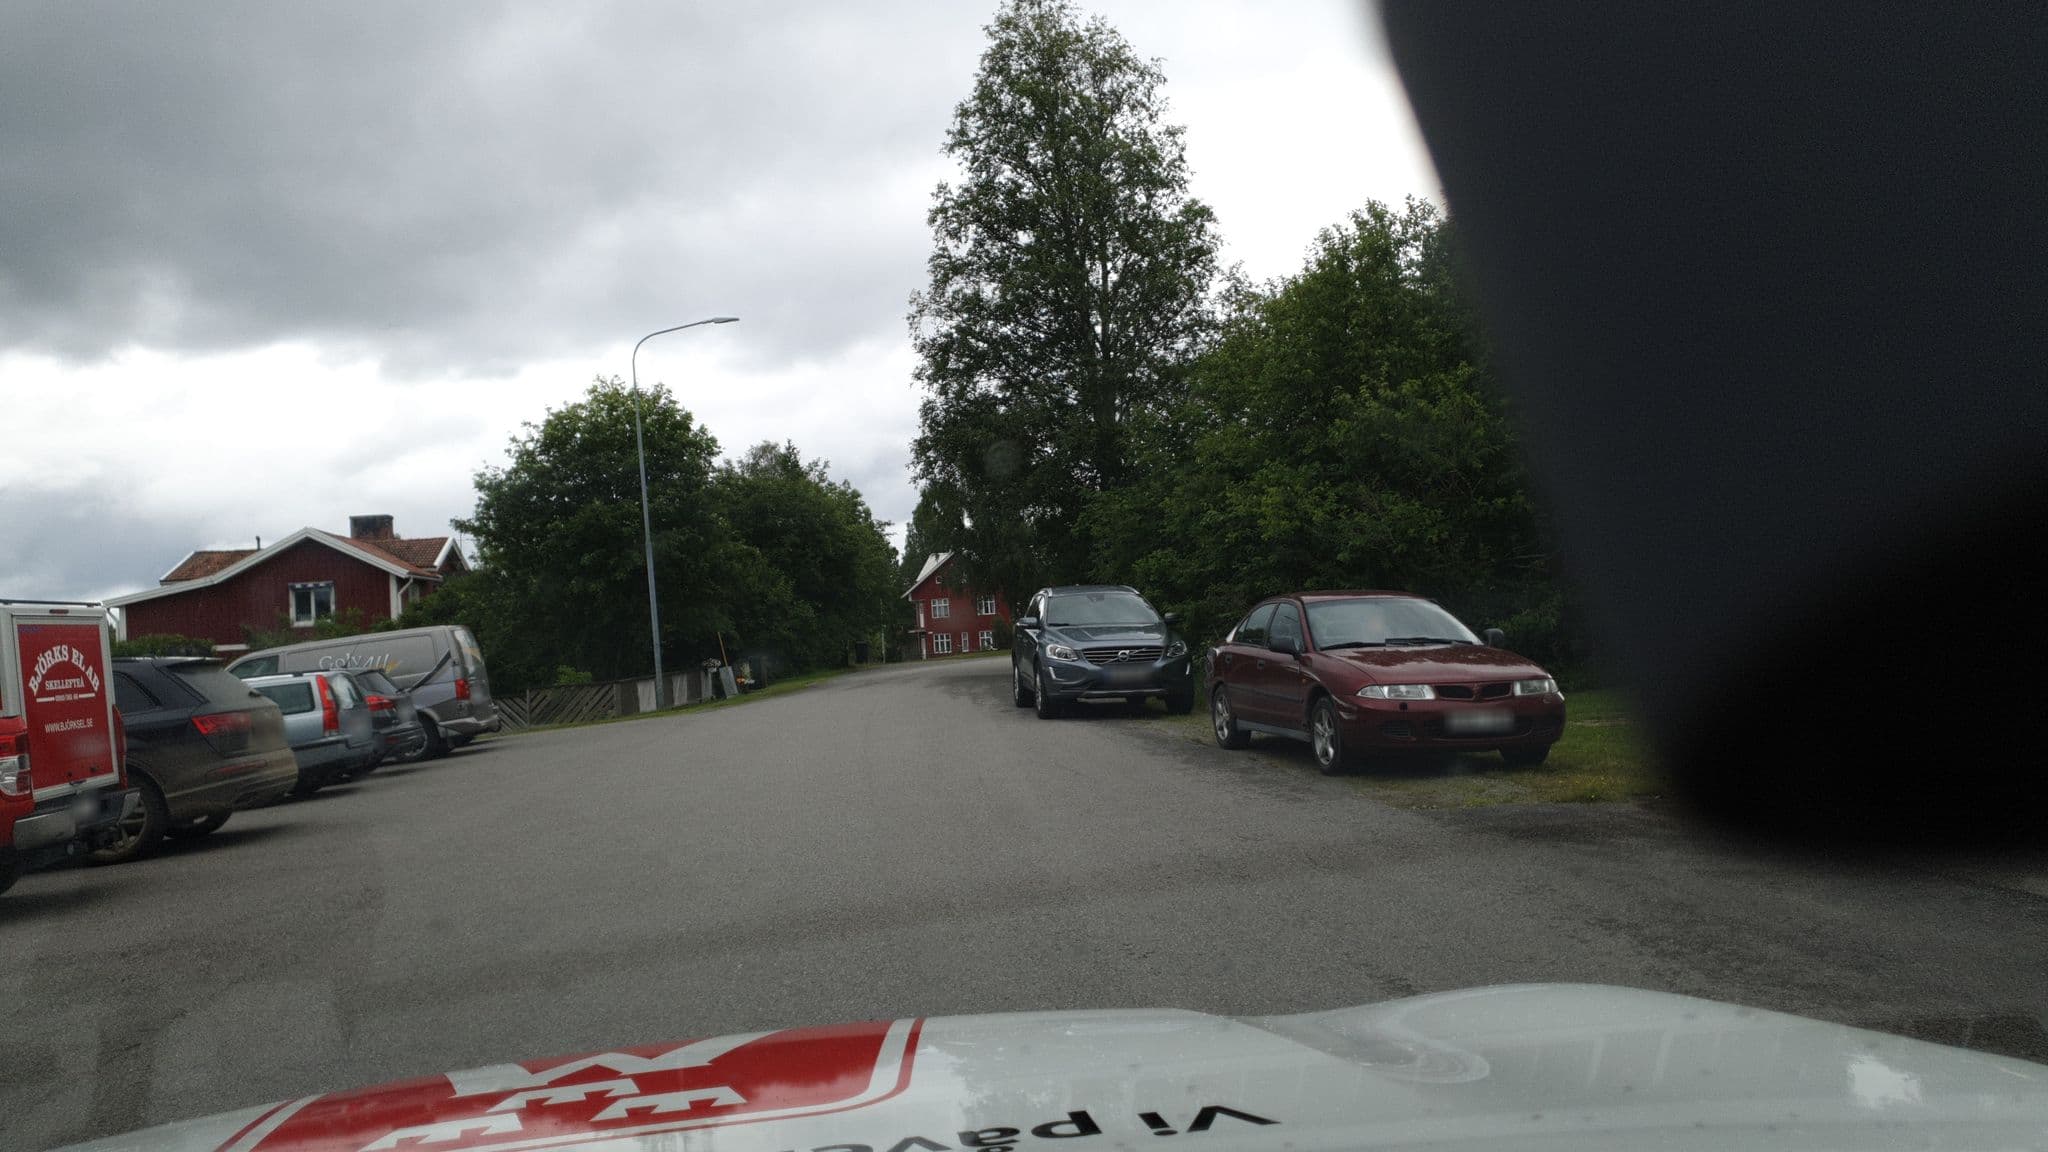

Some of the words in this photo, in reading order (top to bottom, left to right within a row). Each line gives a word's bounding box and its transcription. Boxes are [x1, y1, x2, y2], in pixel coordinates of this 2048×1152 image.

[28, 644, 68, 696] BJÖRKS
[72, 647, 85, 672] EL
[86, 665, 100, 692] AB
[45, 676, 84, 690] SKELLEFTEÅ
[1138, 1105, 1282, 1137] Vi
